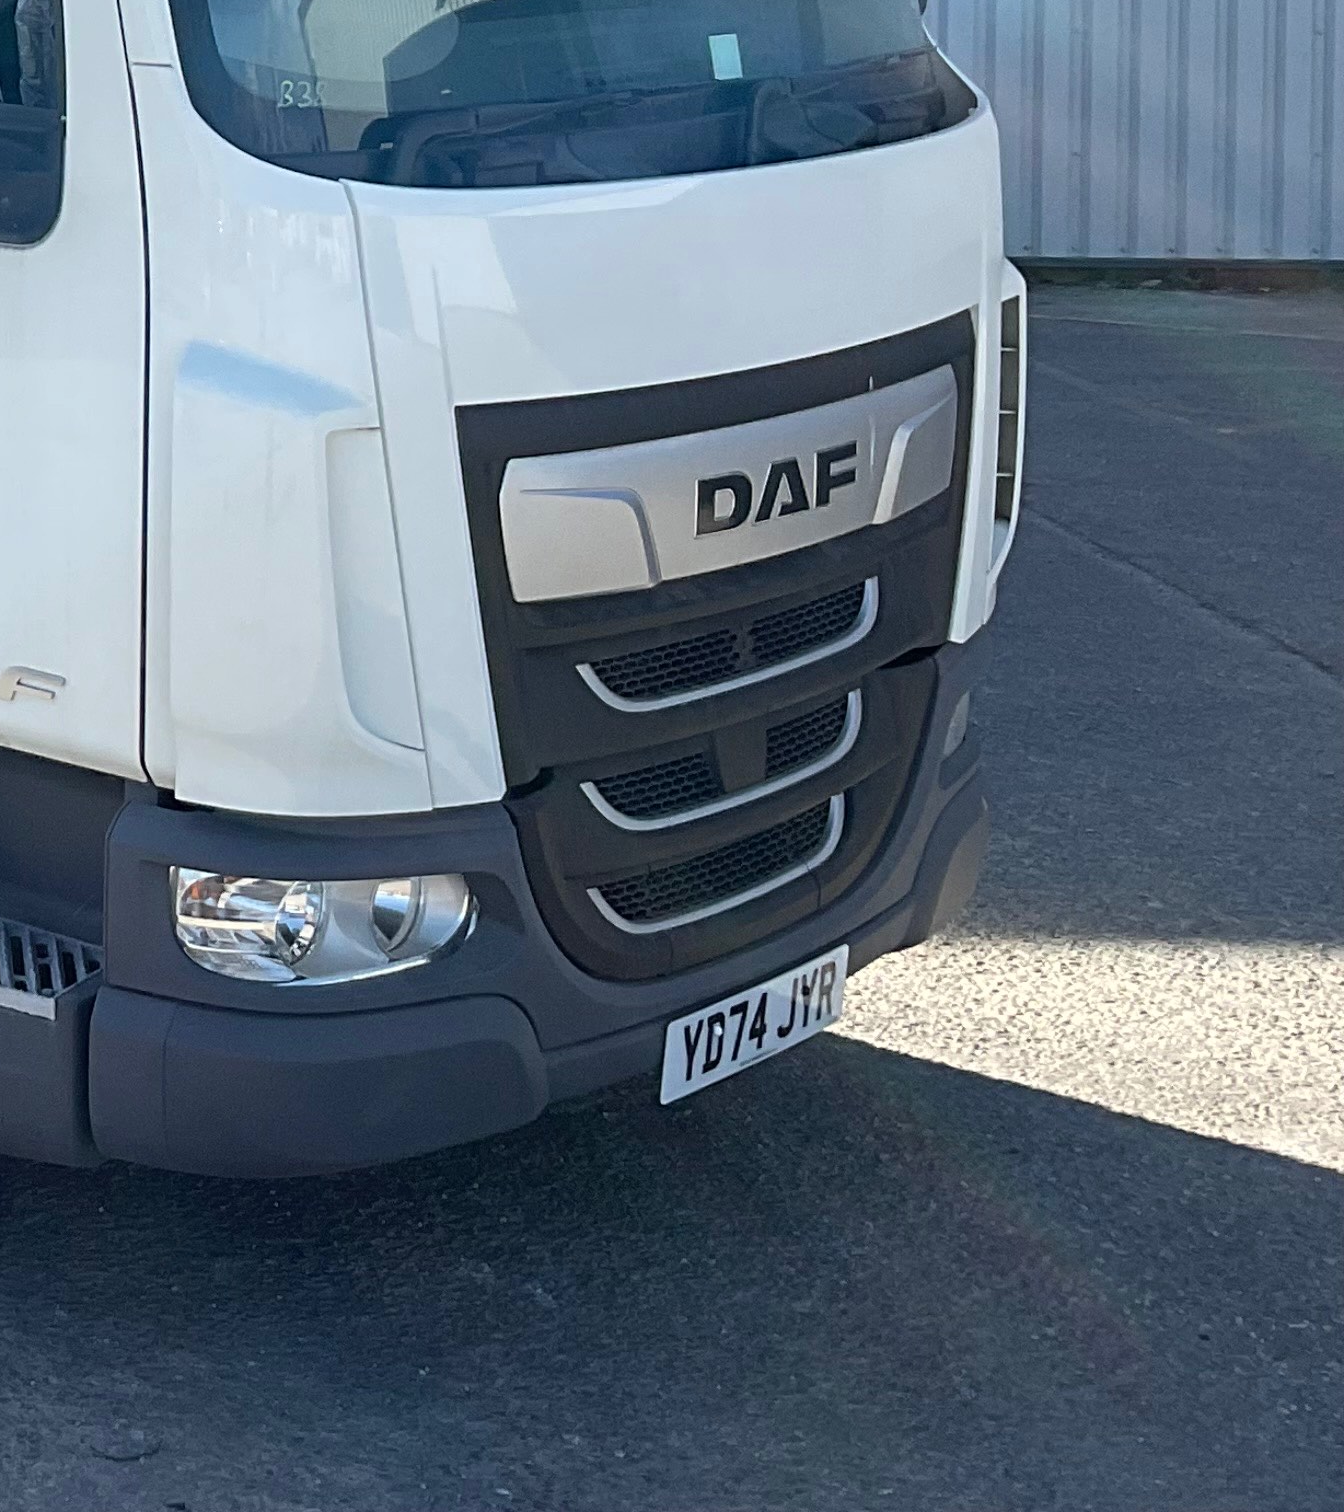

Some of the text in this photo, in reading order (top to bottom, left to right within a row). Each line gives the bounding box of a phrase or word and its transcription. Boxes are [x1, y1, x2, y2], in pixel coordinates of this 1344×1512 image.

[694, 440, 858, 538] DAF
[683, 960, 837, 1081] YD74 JYR
